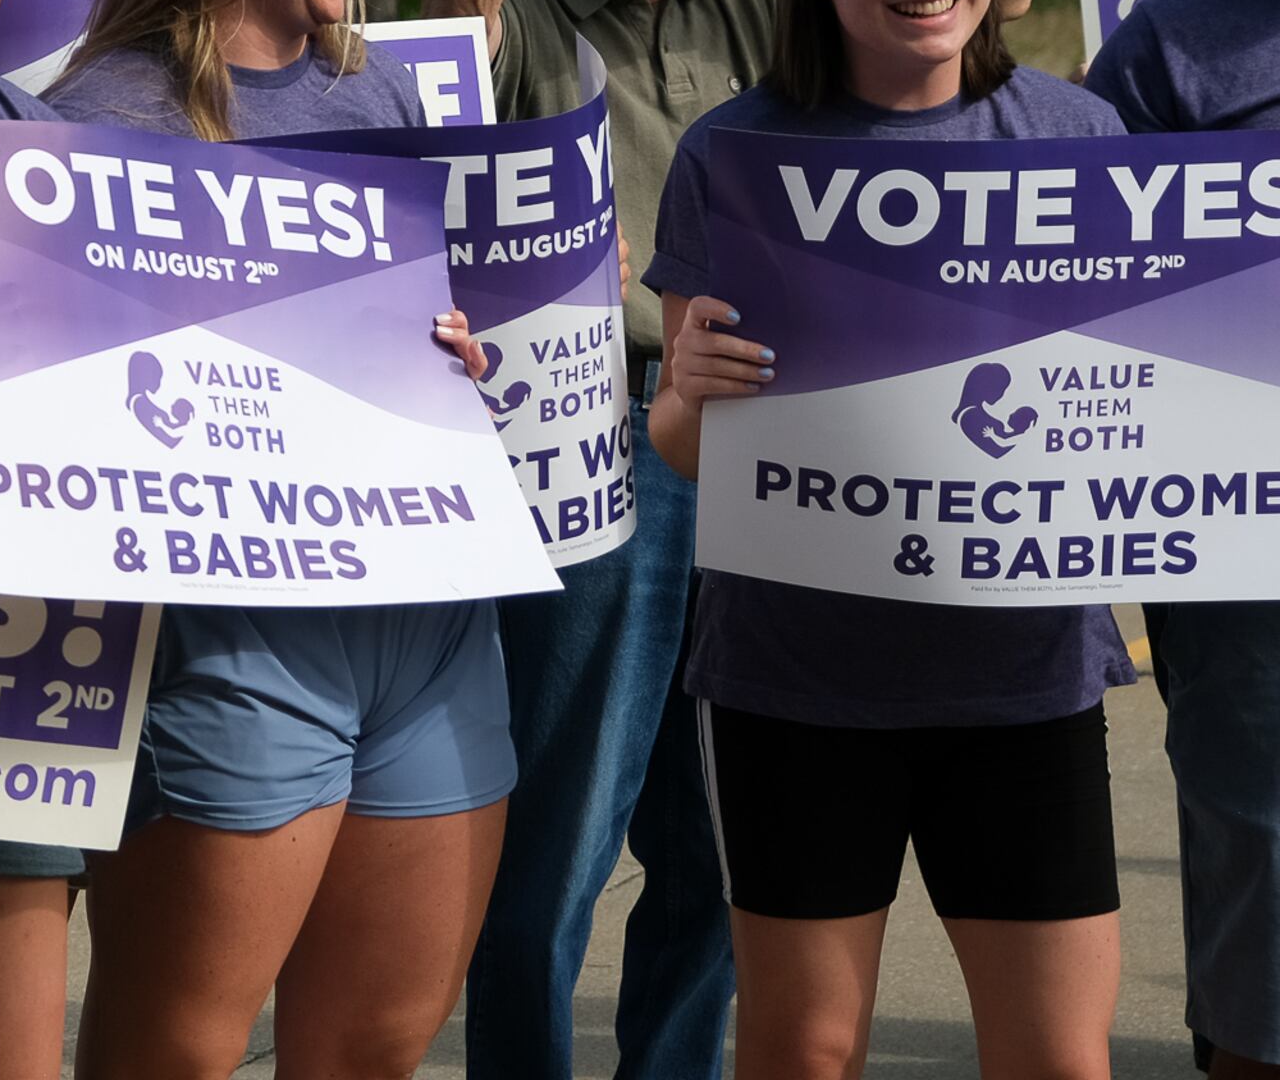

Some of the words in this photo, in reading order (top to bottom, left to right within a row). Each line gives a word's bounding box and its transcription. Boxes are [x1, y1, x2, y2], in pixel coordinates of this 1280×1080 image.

[194, 169, 393, 262] YES!
[778, 165, 1077, 247] VOTE
[85, 242, 126, 270] ON
[132, 250, 237, 283] AUGUST
[243, 259, 279, 284] 2ND
[484, 218, 597, 266] AUGUST
[939, 259, 991, 284] ON
[1000, 256, 1135, 284] AUGUST
[1142, 254, 1186, 279] 2ND
[529, 316, 613, 365] VALUE
[184, 359, 283, 393] VALUE
[550, 355, 605, 388] THEM
[1039, 363, 1156, 393] VALUE
[208, 395, 271, 419] THEM
[540, 377, 613, 423] BOTH
[1058, 397, 1132, 419] THEM
[205, 422, 286, 455] BOTH
[1044, 424, 1145, 453] BOTH
[249, 479, 476, 528] WOMEN
[755, 459, 1066, 525] PROTECT
[114, 526, 148, 574] &
[165, 529, 367, 581] BABIES
[893, 533, 936, 578] &
[961, 530, 1198, 580] BABIES
[36, 680, 116, 730] 2ND
